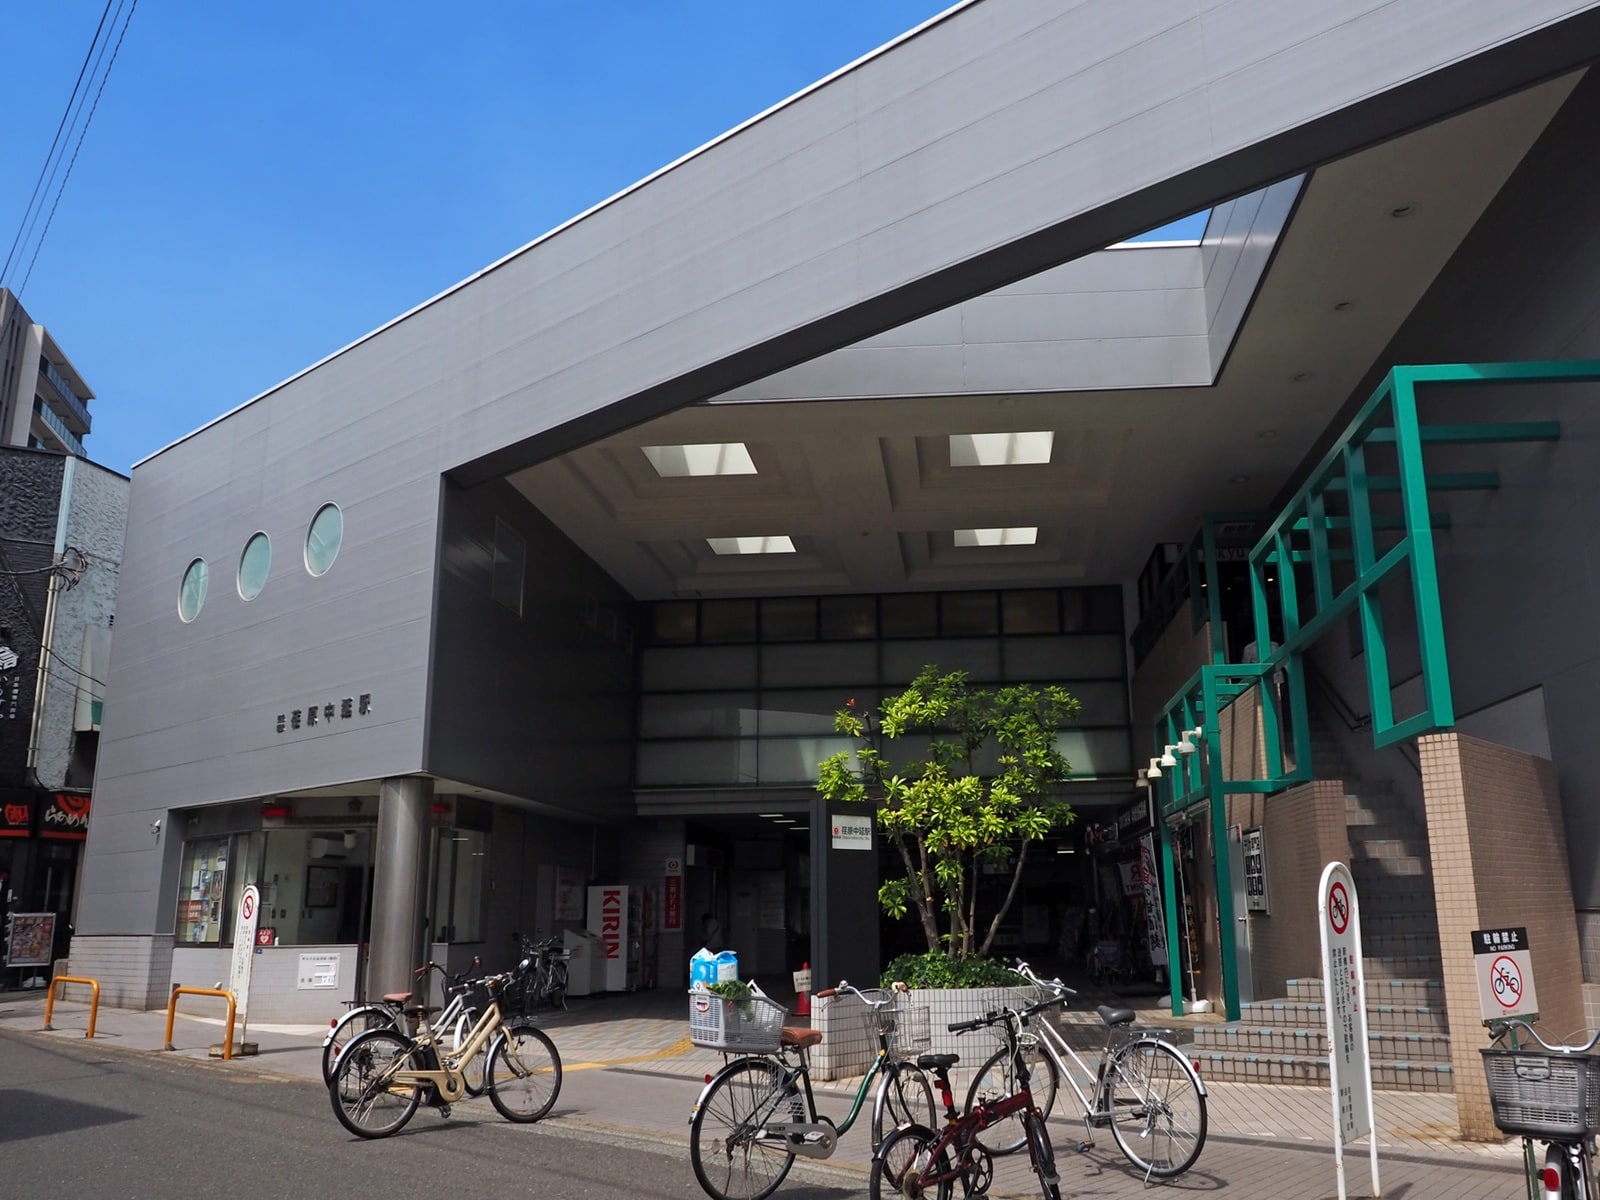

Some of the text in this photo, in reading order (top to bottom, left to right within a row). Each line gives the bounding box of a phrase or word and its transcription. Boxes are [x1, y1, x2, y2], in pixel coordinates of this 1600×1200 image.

[602, 890, 621, 959] KIRIN
[1483, 931, 1519, 945] 駐輪禁止
